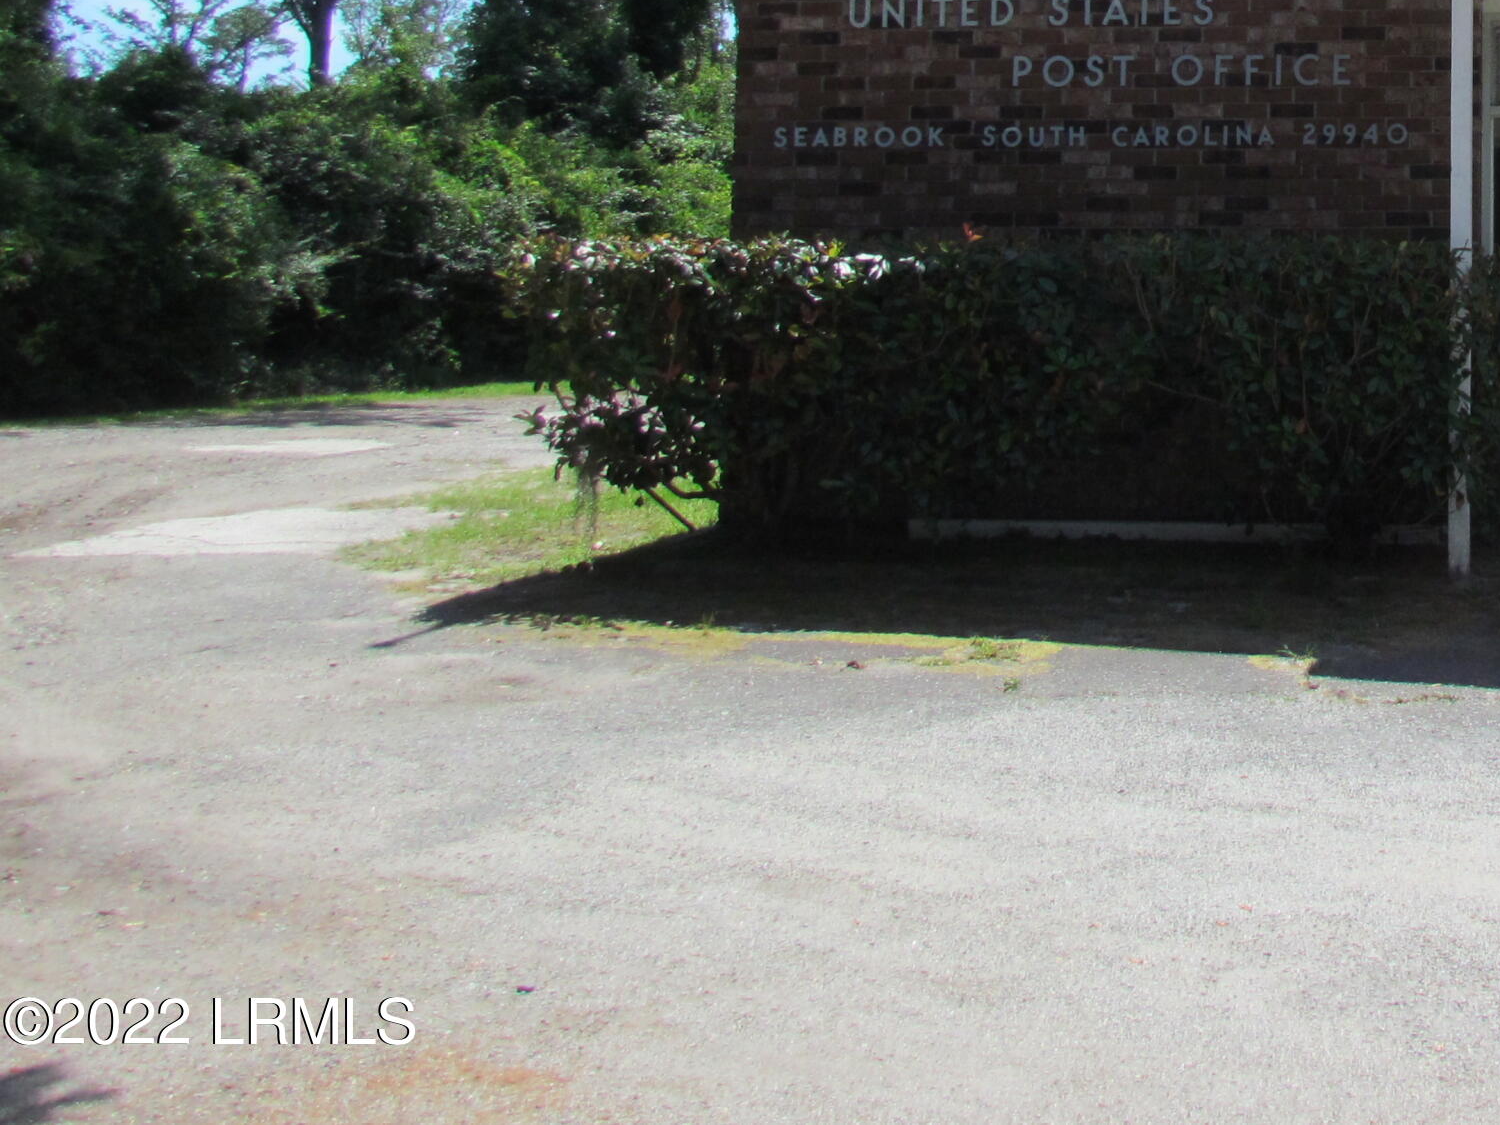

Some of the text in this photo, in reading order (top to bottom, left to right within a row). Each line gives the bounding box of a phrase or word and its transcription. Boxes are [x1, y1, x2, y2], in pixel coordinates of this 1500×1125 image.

[1011, 53, 1351, 88] POST OFFICE
[773, 122, 1409, 149] SEABROOK SOUTH CAROLINA 29940
